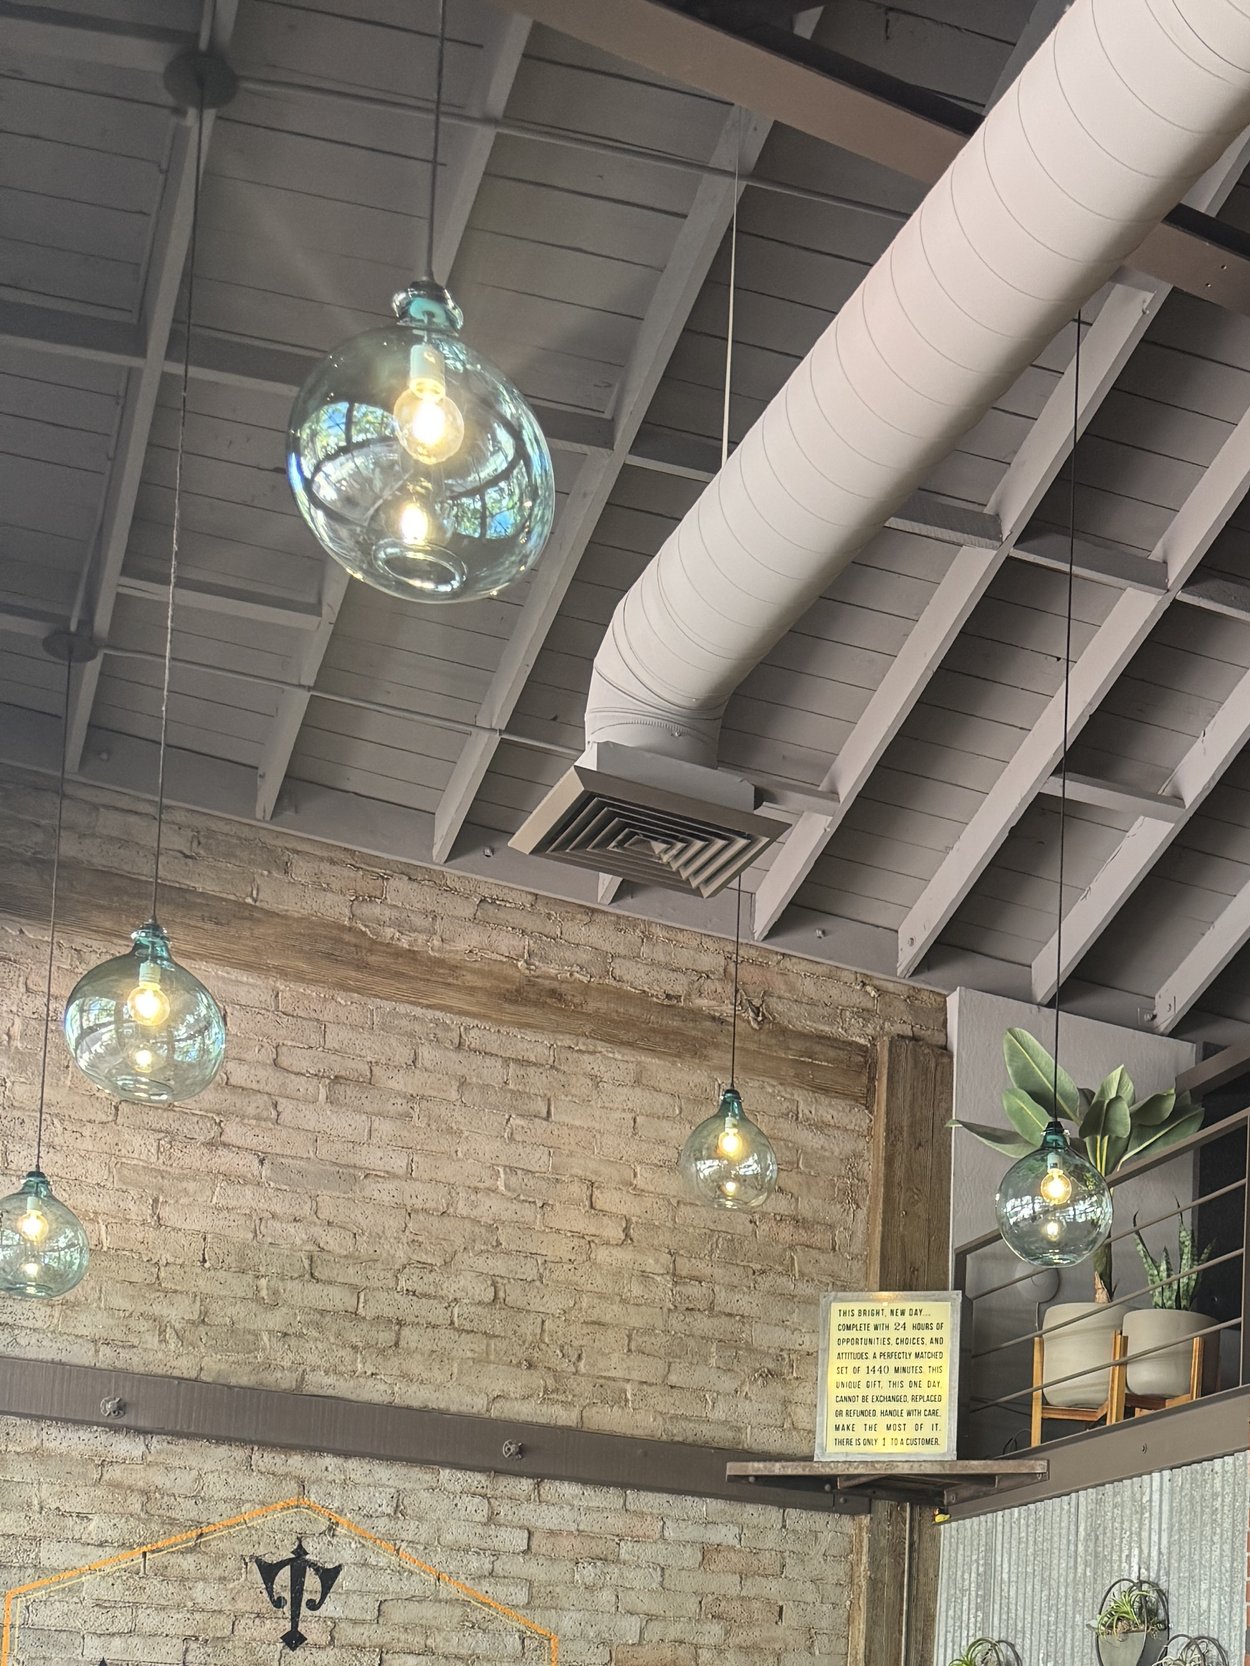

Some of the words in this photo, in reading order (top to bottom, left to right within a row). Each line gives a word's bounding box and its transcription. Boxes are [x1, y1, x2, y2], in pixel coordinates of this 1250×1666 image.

[839, 1309, 854, 1317] THIS
[858, 1309, 887, 1317] BRIGHT,
[838, 1323, 870, 1331] COMPLETE
[874, 1323, 889, 1331] WITH
[894, 1322, 906, 1331] 24
[936, 1322, 944, 1330] OF
[930, 1337, 943, 1345] AND
[915, 1351, 943, 1359] MATCHED
[866, 1365, 889, 1374] 1440
[888, 1380, 904, 1388] THIS
[909, 1380, 922, 1388] ONE
[836, 1395, 859, 1403] CANNOT
[862, 1395, 869, 1403] BE
[881, 1409, 903, 1417] HANDLE
[835, 1438, 853, 1446] THERE
[855, 1438, 860, 1446] IS
[863, 1438, 877, 1446] ONLY
[882, 1438, 886, 1446] 1
[891, 1438, 898, 1446] TO
[900, 1438, 904, 1446] A
